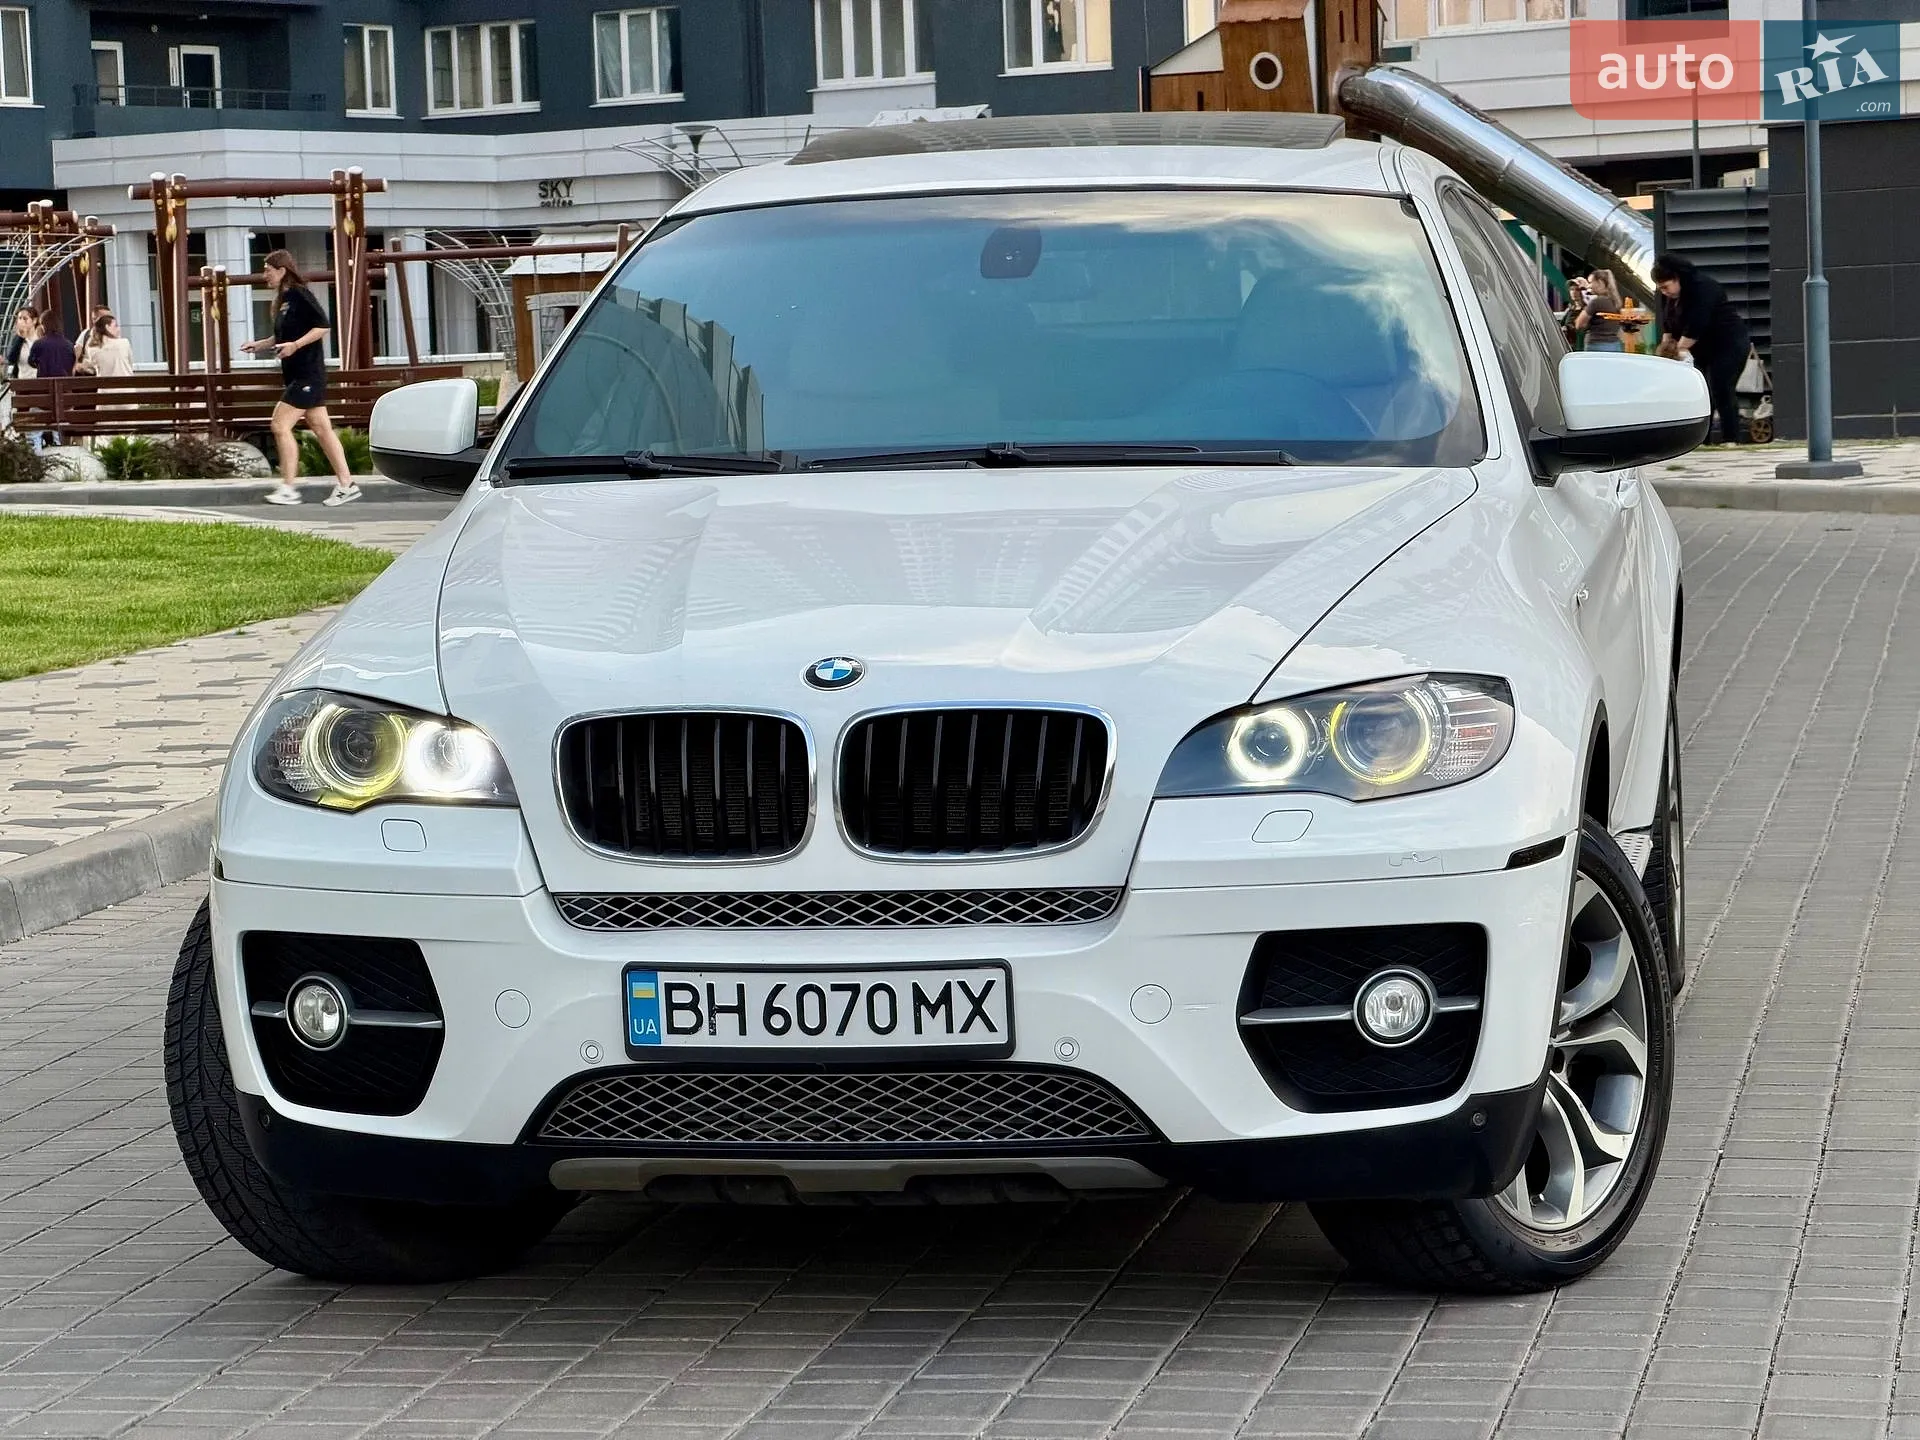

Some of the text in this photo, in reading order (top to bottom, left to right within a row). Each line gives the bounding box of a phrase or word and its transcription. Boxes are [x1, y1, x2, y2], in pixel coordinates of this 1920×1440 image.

[539, 179, 574, 198] SKY
[664, 979, 999, 1036] BH 6070 MX
[633, 1018, 658, 1035] UA
